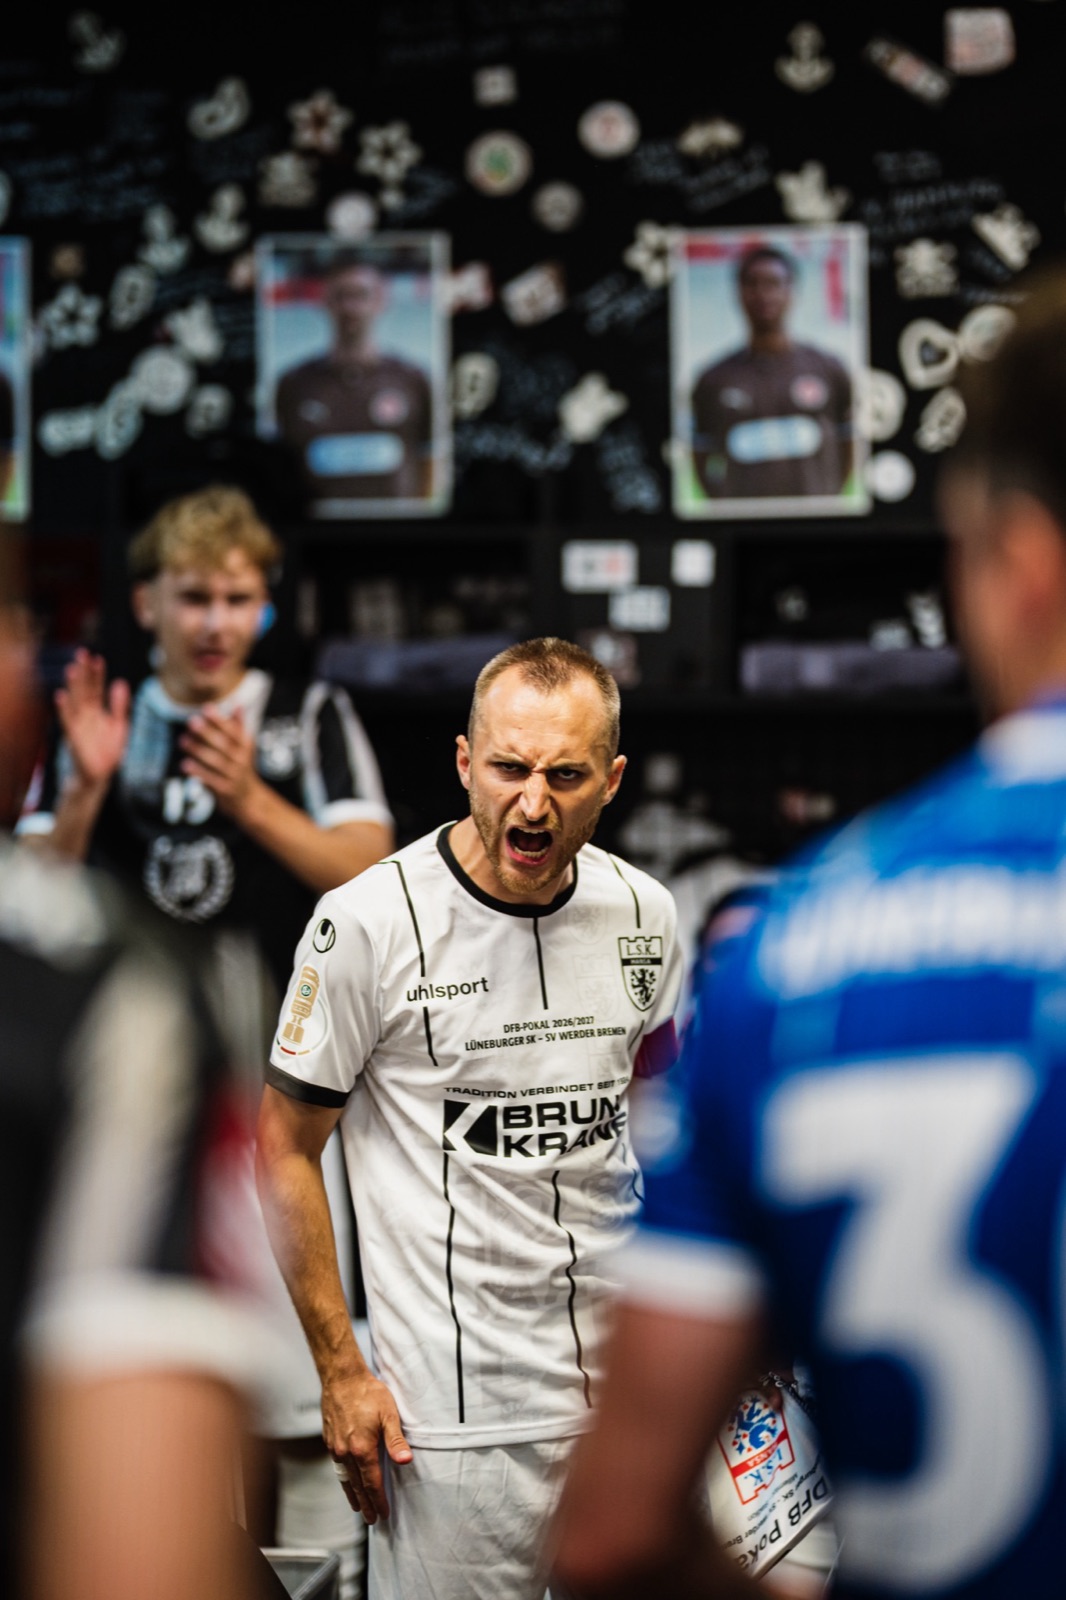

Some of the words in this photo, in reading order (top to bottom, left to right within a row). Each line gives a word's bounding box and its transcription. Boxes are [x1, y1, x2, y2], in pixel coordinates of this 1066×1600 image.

[406, 976, 489, 1002] uhlsport
[503, 1020, 550, 1034] DFB-POKAL
[552, 1016, 595, 1028] 2026/2027
[465, 1037, 525, 1051] LÜNEBURGER
[526, 1034, 536, 1044] SK
[545, 1032, 557, 1042] SV
[560, 1028, 595, 1041] WERDER
[597, 1026, 627, 1037] BREMEN
[443, 1086, 517, 1099] TRADITION
[519, 1083, 594, 1097] VERBINDET
[597, 1079, 616, 1090] SEIT
[788, 1475, 828, 1527] DFB
[736, 1519, 782, 1571] Poka
